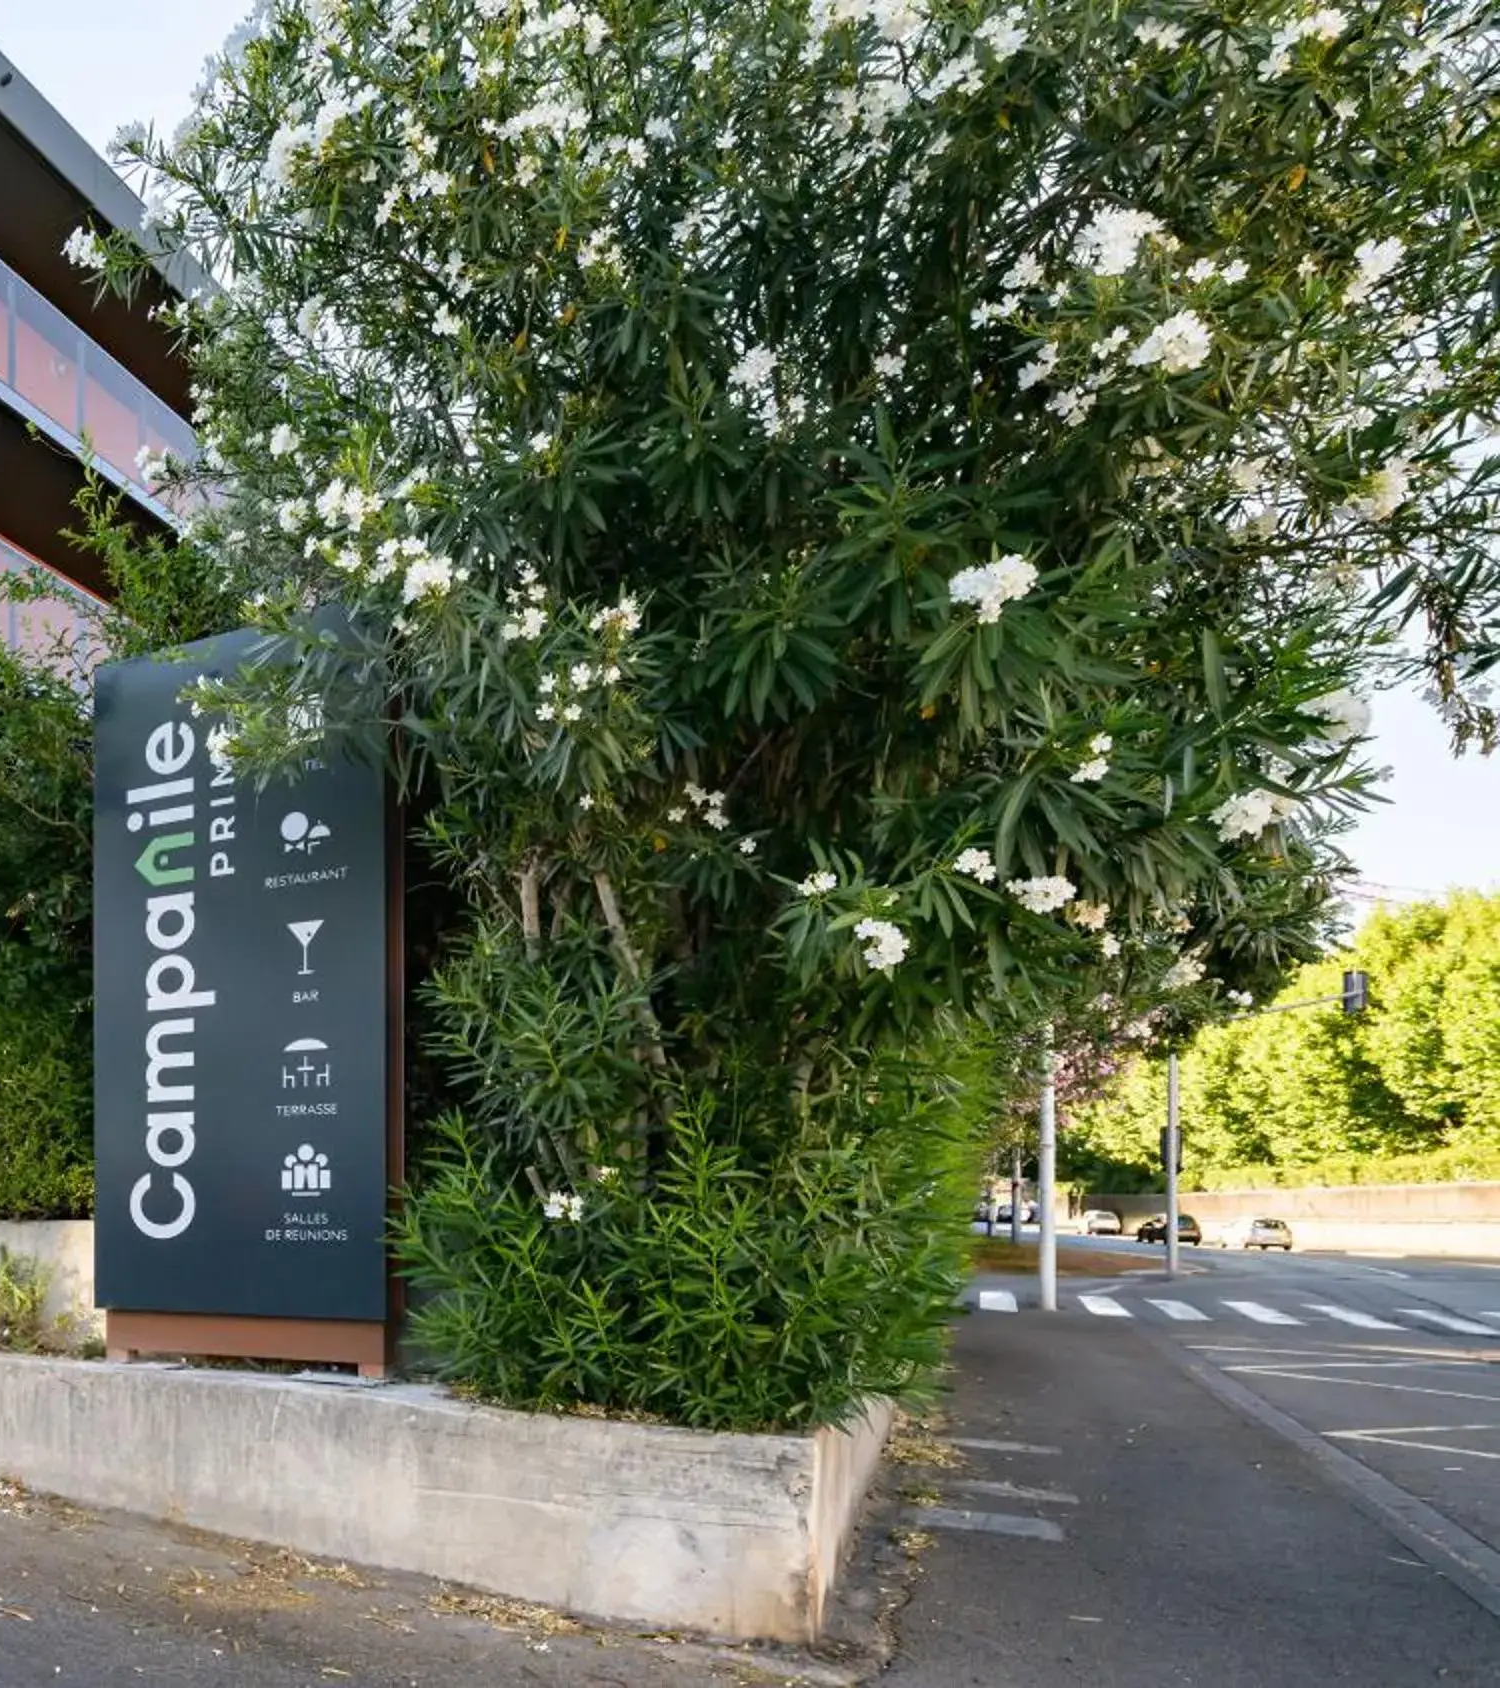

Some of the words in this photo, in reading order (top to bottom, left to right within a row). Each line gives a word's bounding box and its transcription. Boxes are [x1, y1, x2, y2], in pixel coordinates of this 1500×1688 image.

[264, 866, 349, 889] RESTAURANT
[126, 721, 216, 1239] Campanile
[292, 989, 320, 1003] BAR
[275, 1103, 339, 1116] TERRASSE
[283, 1212, 330, 1225] SALLES
[265, 1229, 282, 1241] DE
